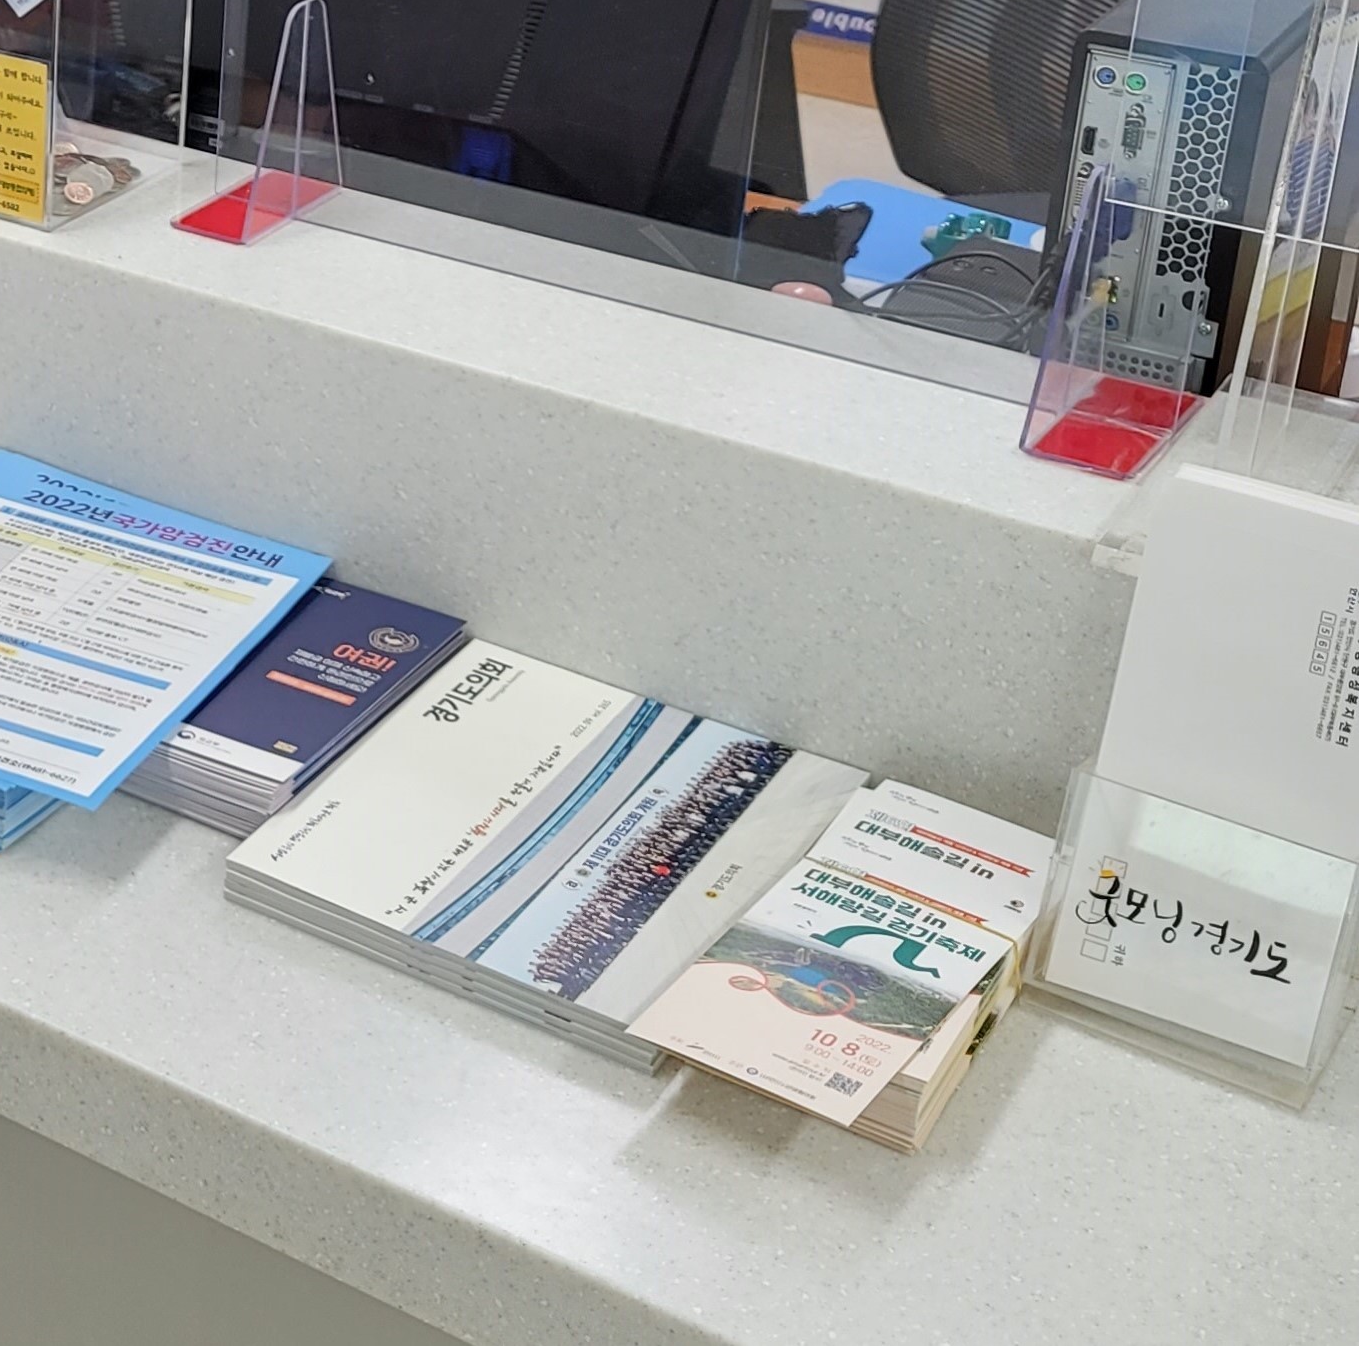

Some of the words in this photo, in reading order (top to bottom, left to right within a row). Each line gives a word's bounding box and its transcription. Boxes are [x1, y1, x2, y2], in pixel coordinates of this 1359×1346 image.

[22, 485, 286, 570] 2022년국가암검진안내
[332, 640, 397, 674] 여권!
[420, 656, 516, 726] 경기도의회
[600, 810, 646, 848] 경기도의회
[633, 795, 661, 814] 개원
[852, 817, 971, 871] 대부해솔길
[968, 862, 996, 880] in
[789, 877, 889, 926] 서해랑길
[884, 914, 987, 964] 걷기축제
[802, 864, 923, 922] 대부해솔길
[919, 912, 950, 930] in
